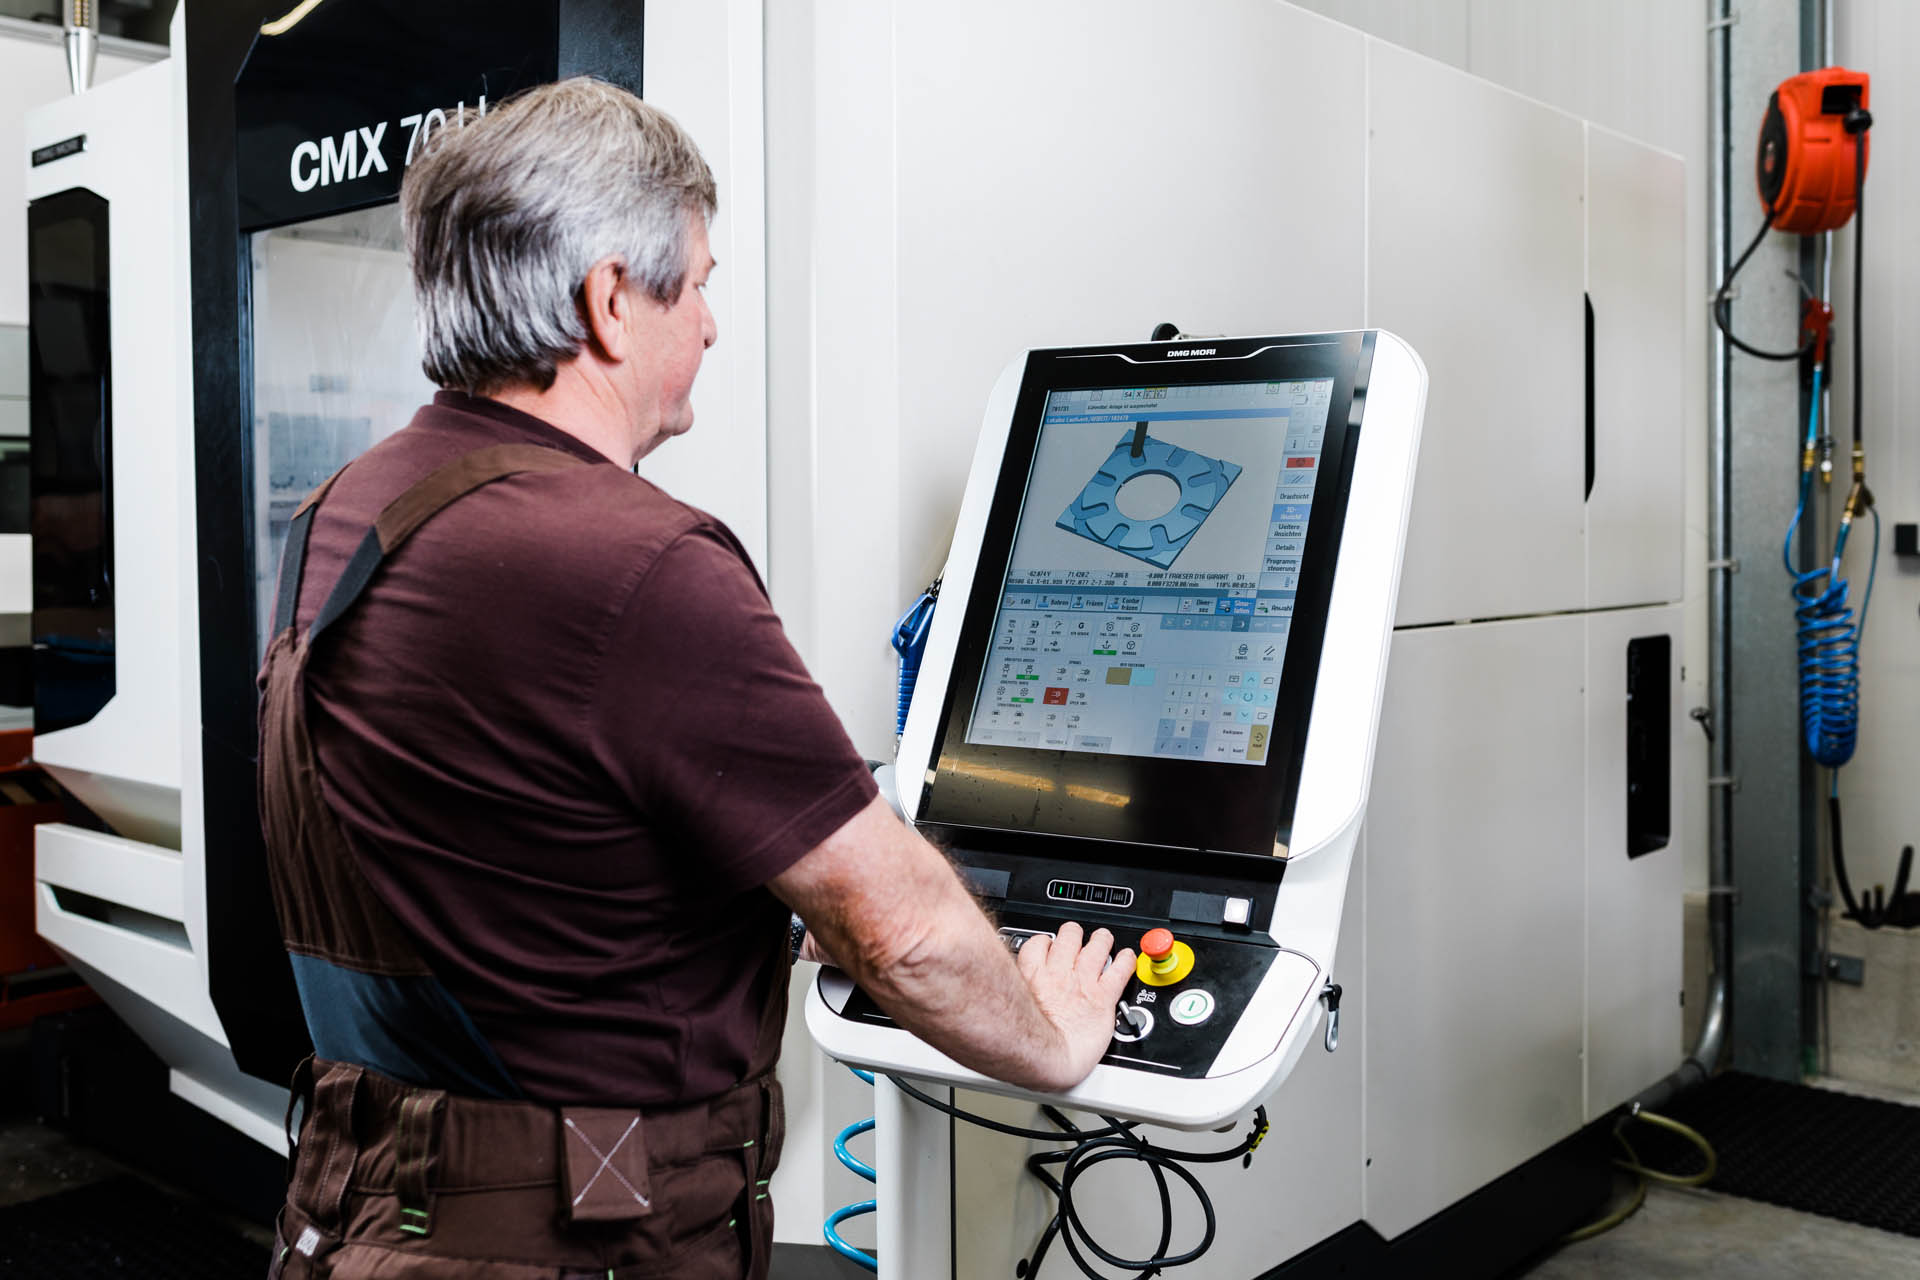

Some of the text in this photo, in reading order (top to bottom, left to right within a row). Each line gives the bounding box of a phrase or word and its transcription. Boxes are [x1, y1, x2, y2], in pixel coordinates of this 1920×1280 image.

[290, 121, 389, 193] CMX
[1167, 348, 1216, 358] DMG MORI
